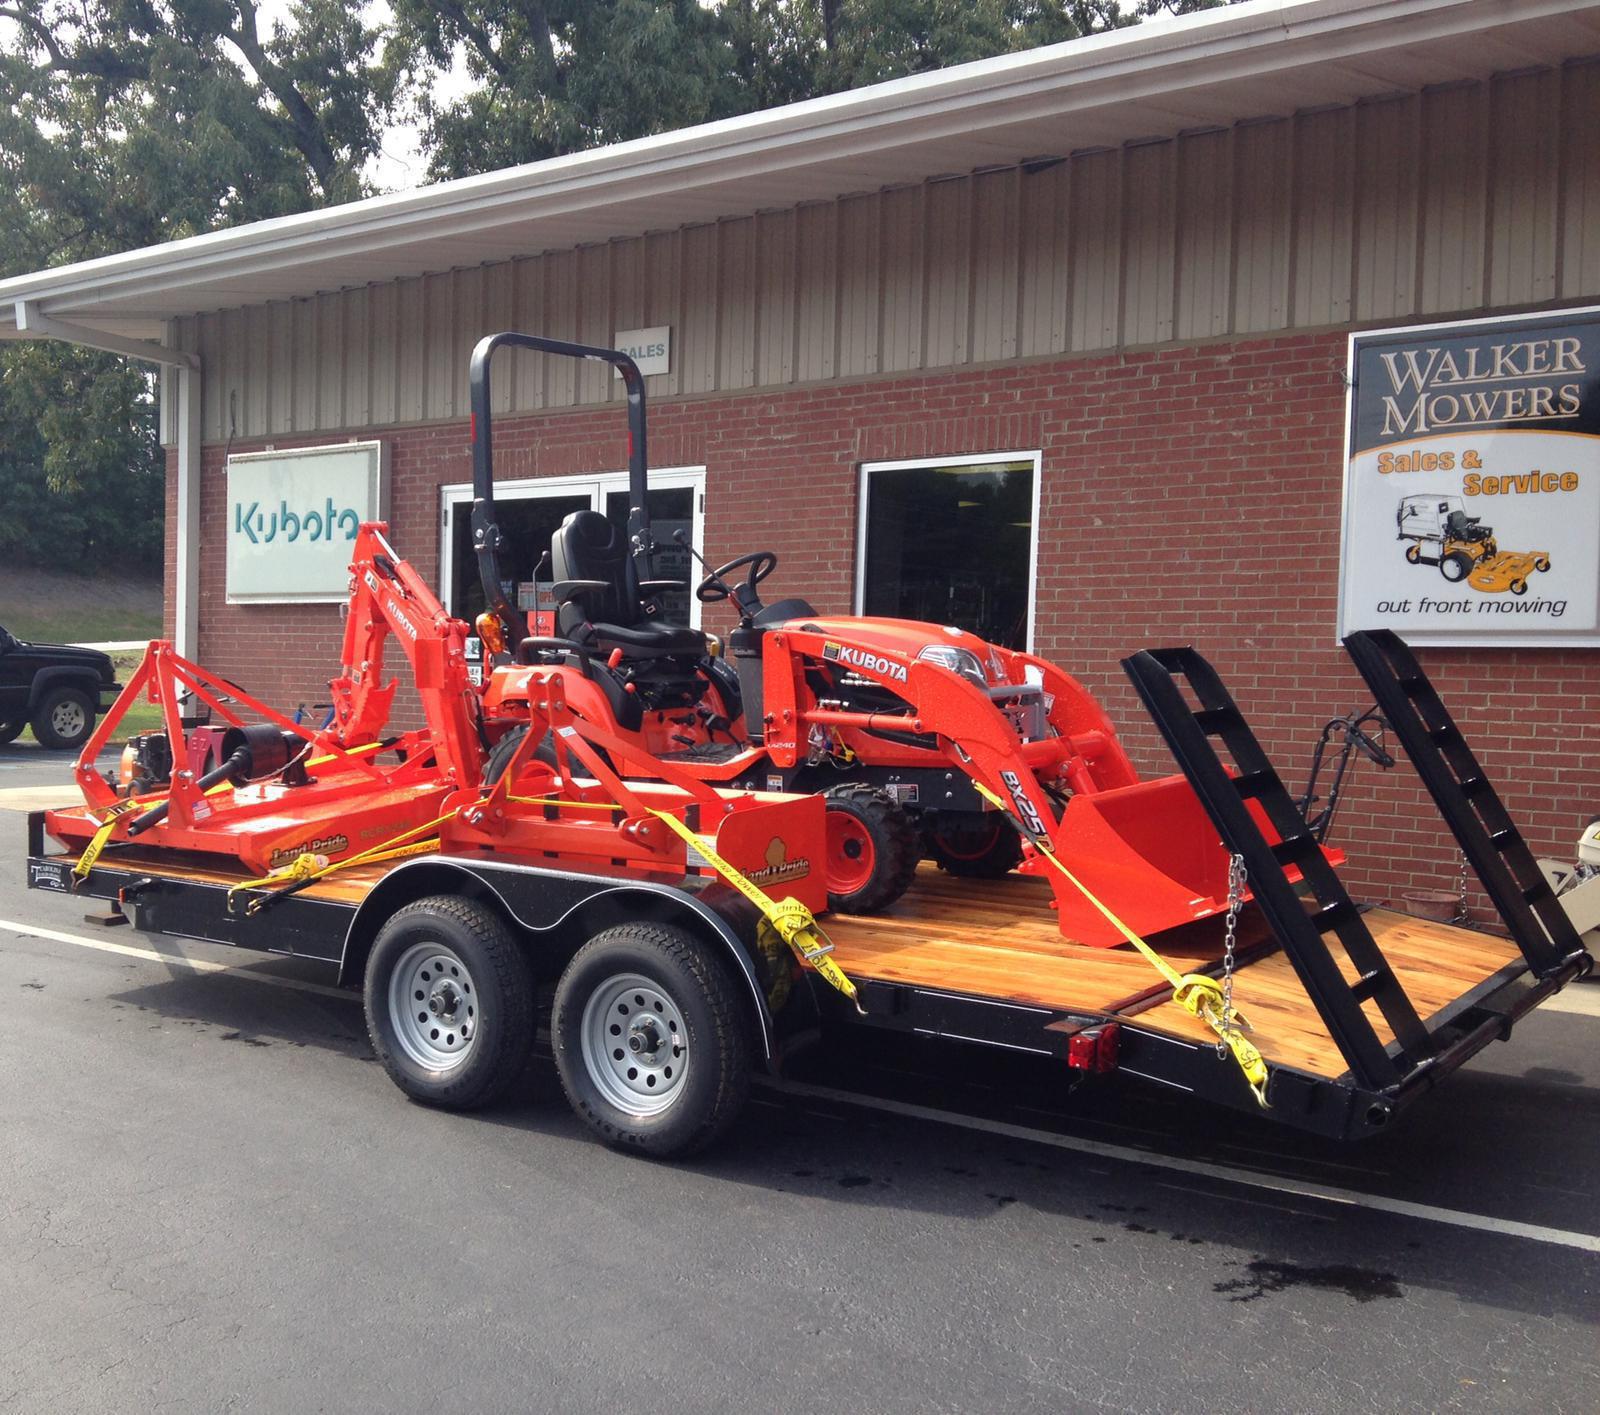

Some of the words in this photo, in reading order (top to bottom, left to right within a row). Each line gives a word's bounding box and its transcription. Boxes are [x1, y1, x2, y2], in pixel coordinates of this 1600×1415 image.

[1380, 337, 1585, 394] WALKER
[1380, 384, 1581, 435] MOWERS
[1377, 450, 1455, 474] Sales
[1461, 450, 1482, 469] &
[1463, 470, 1579, 496] Service
[236, 498, 359, 543] Kubota
[387, 599, 417, 641] KUBOTA
[1377, 599, 1412, 613] out
[1418, 598, 1471, 613] front
[1479, 598, 1567, 616] mowing
[840, 646, 908, 682] KUBOTA
[312, 834, 347, 850] Pride
